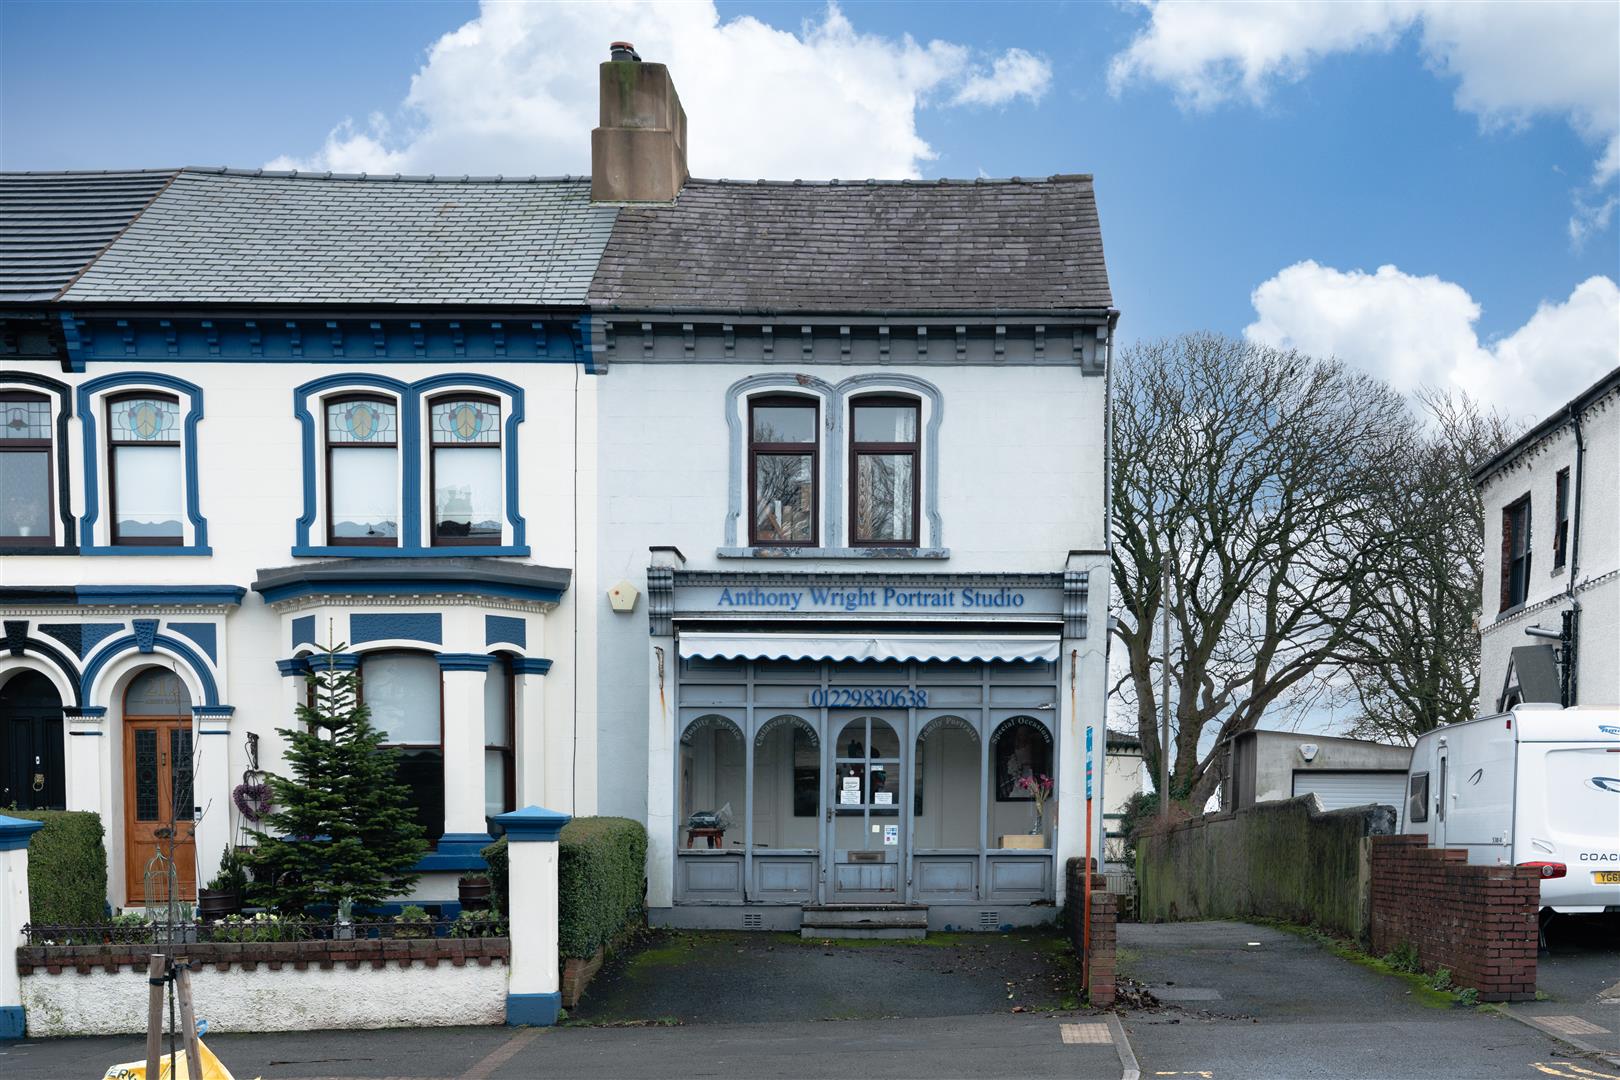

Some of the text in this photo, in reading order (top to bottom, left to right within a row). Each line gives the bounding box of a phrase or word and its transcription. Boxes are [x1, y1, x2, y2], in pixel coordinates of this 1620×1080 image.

[717, 587, 1024, 611] Anthony Wright Portrait Studio
[811, 689, 927, 708] 01229830638
[682, 718, 709, 743] Quality
[918, 717, 977, 742] Family Portraits
[991, 716, 1050, 745] Special Occasions
[1580, 853, 1620, 861] COAC
